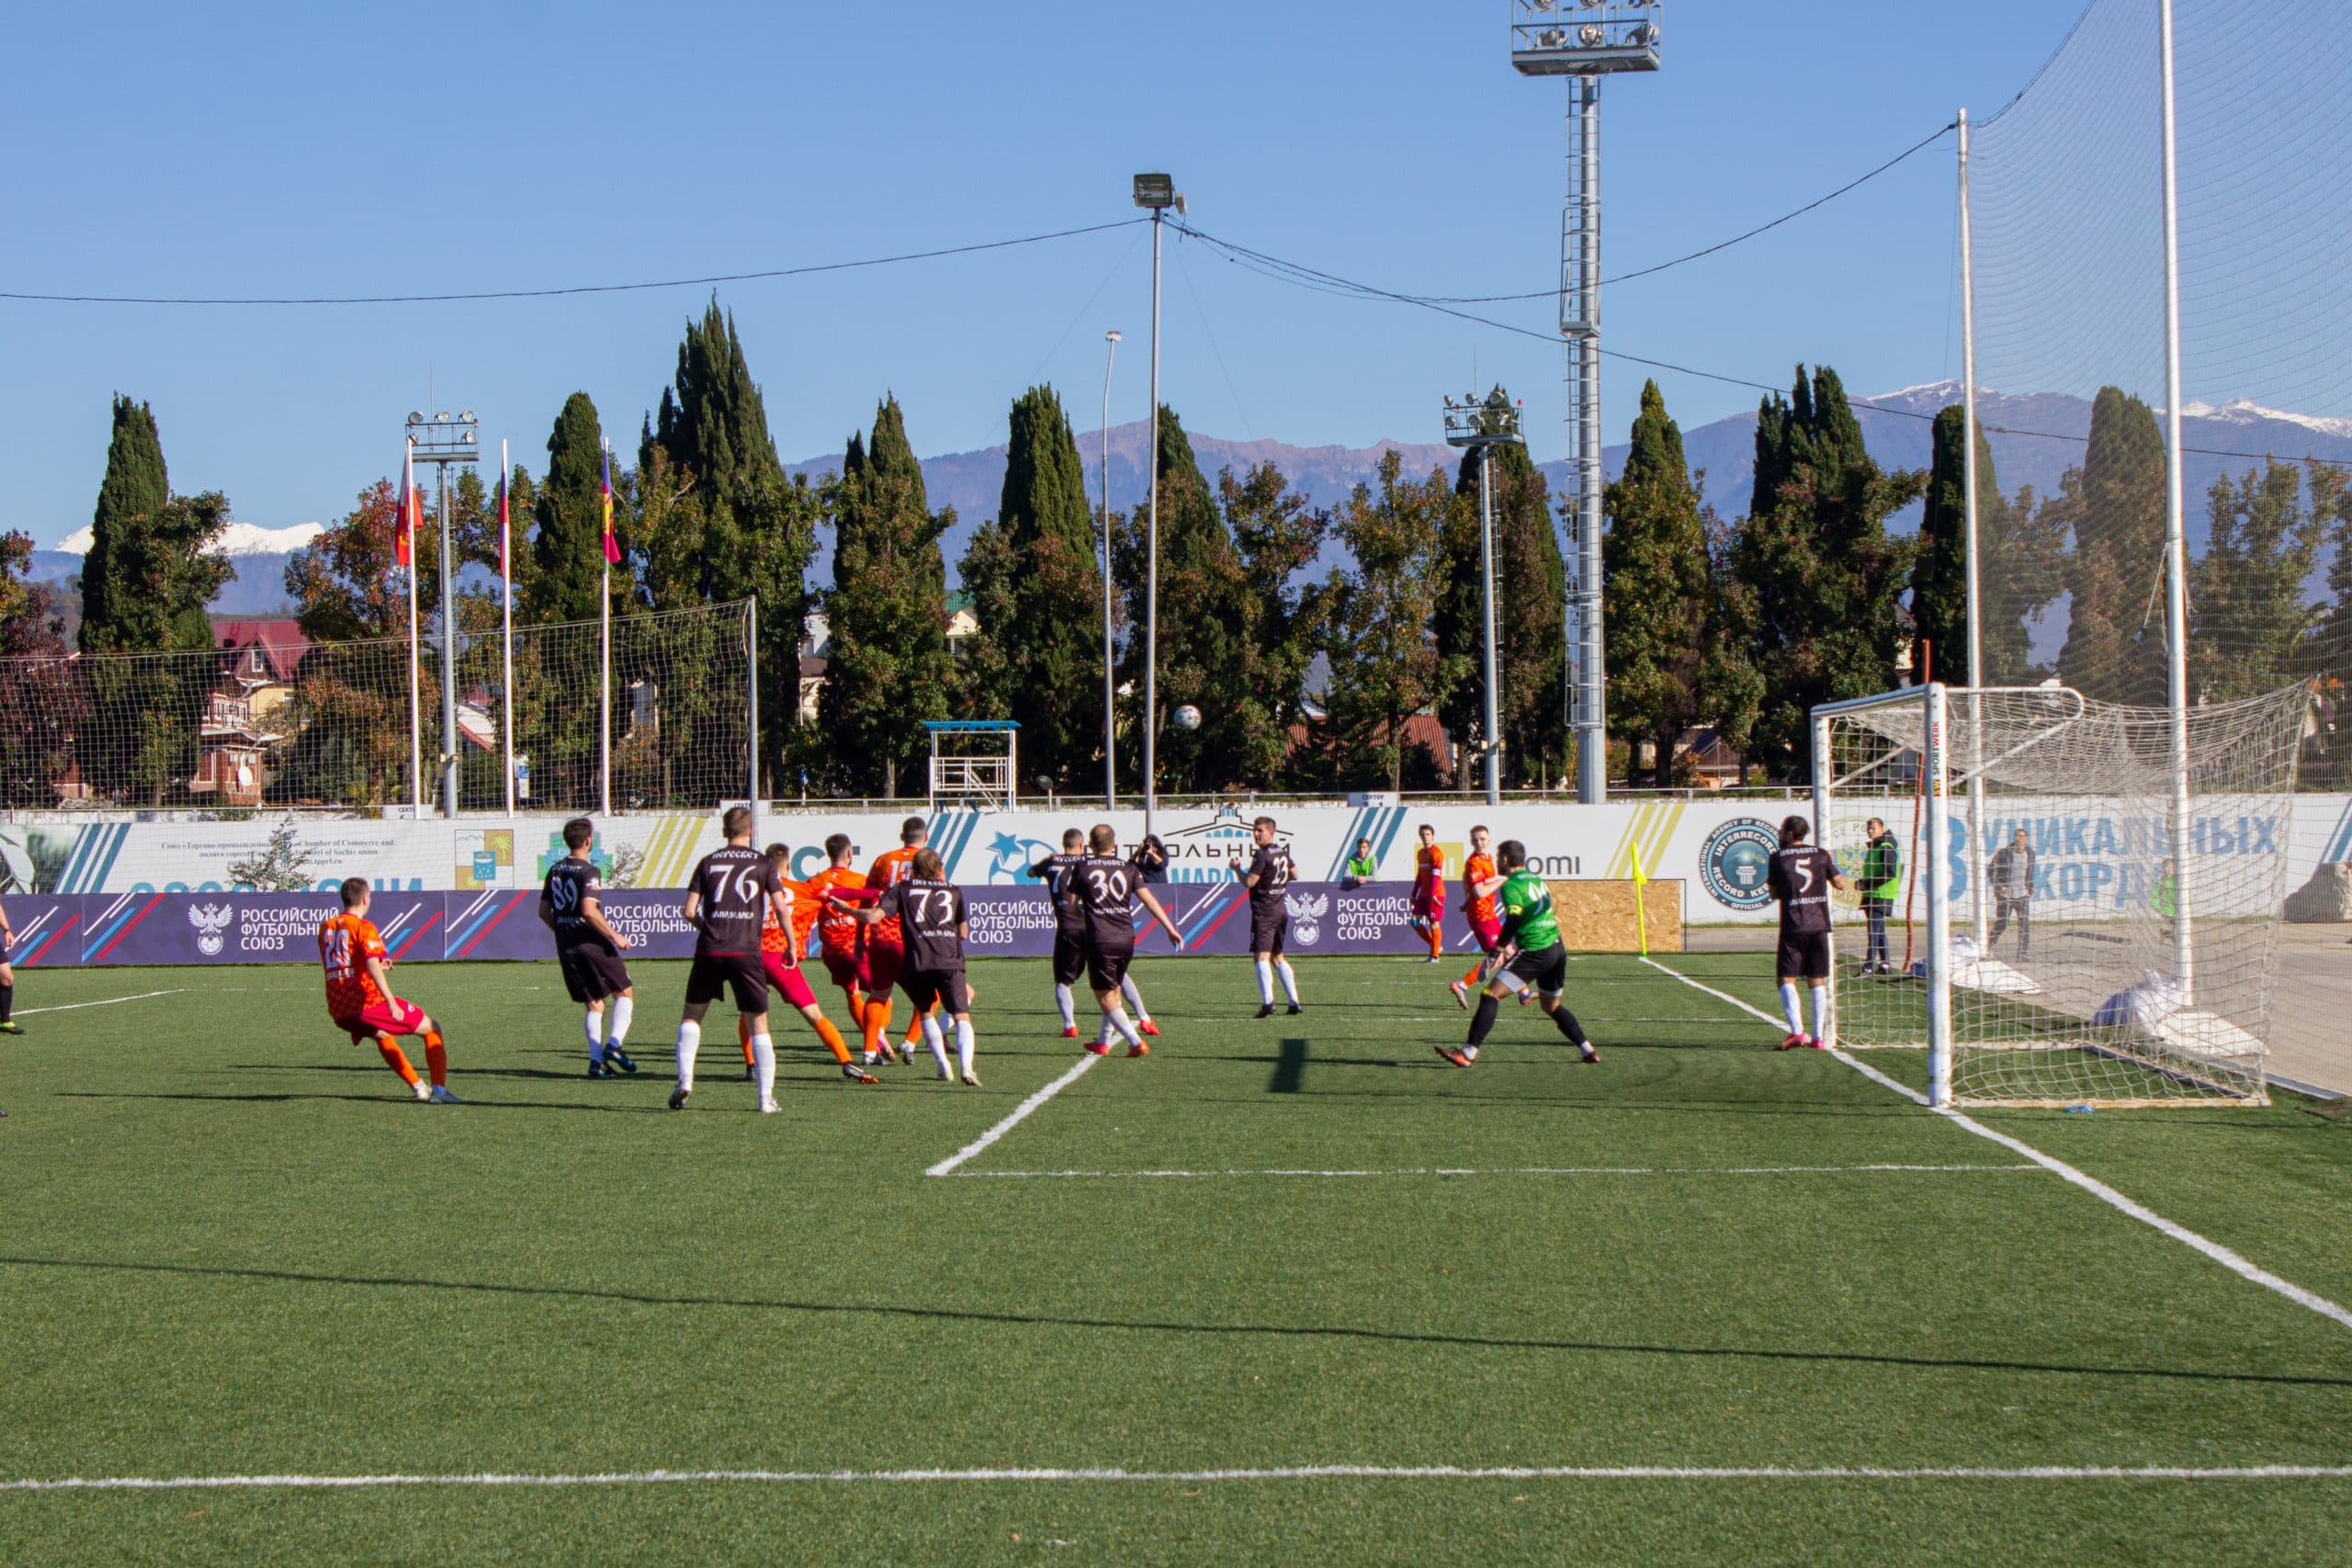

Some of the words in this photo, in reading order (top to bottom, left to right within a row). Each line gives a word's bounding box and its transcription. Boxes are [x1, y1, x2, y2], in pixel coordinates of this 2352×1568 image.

[1932, 721, 1940, 776] SPORTWERK
[1712, 820, 1738, 839] AGENCY
[1714, 830, 1778, 856] INTERRECOR
[1525, 855, 1580, 874] omi
[1713, 866, 1745, 897] RECORD
[1794, 857, 1814, 893] 5
[709, 864, 760, 904] 76
[1088, 870, 1128, 903] 30
[551, 876, 578, 911] 89
[241, 907, 339, 922] РОССИЙСКИЙ
[604, 905, 703, 919] РОССИЙСК
[909, 888, 953, 926] 73
[969, 900, 1055, 915] РОССИЙСКИ
[1731, 902, 1764, 910] OFFICIAL
[605, 919, 697, 932] ФУТБОЛЬНЫ
[969, 916, 1057, 930] ФУТБОЛЬНЫ
[1337, 912, 1430, 925] ФУТБОЛЬН
[241, 923, 320, 936] ФУТБОЛЬН
[969, 930, 1013, 943] СОЮЗ
[1337, 927, 1382, 940] СОЮЗ
[241, 937, 285, 950] СОЮЗ
[323, 929, 351, 969] 20
